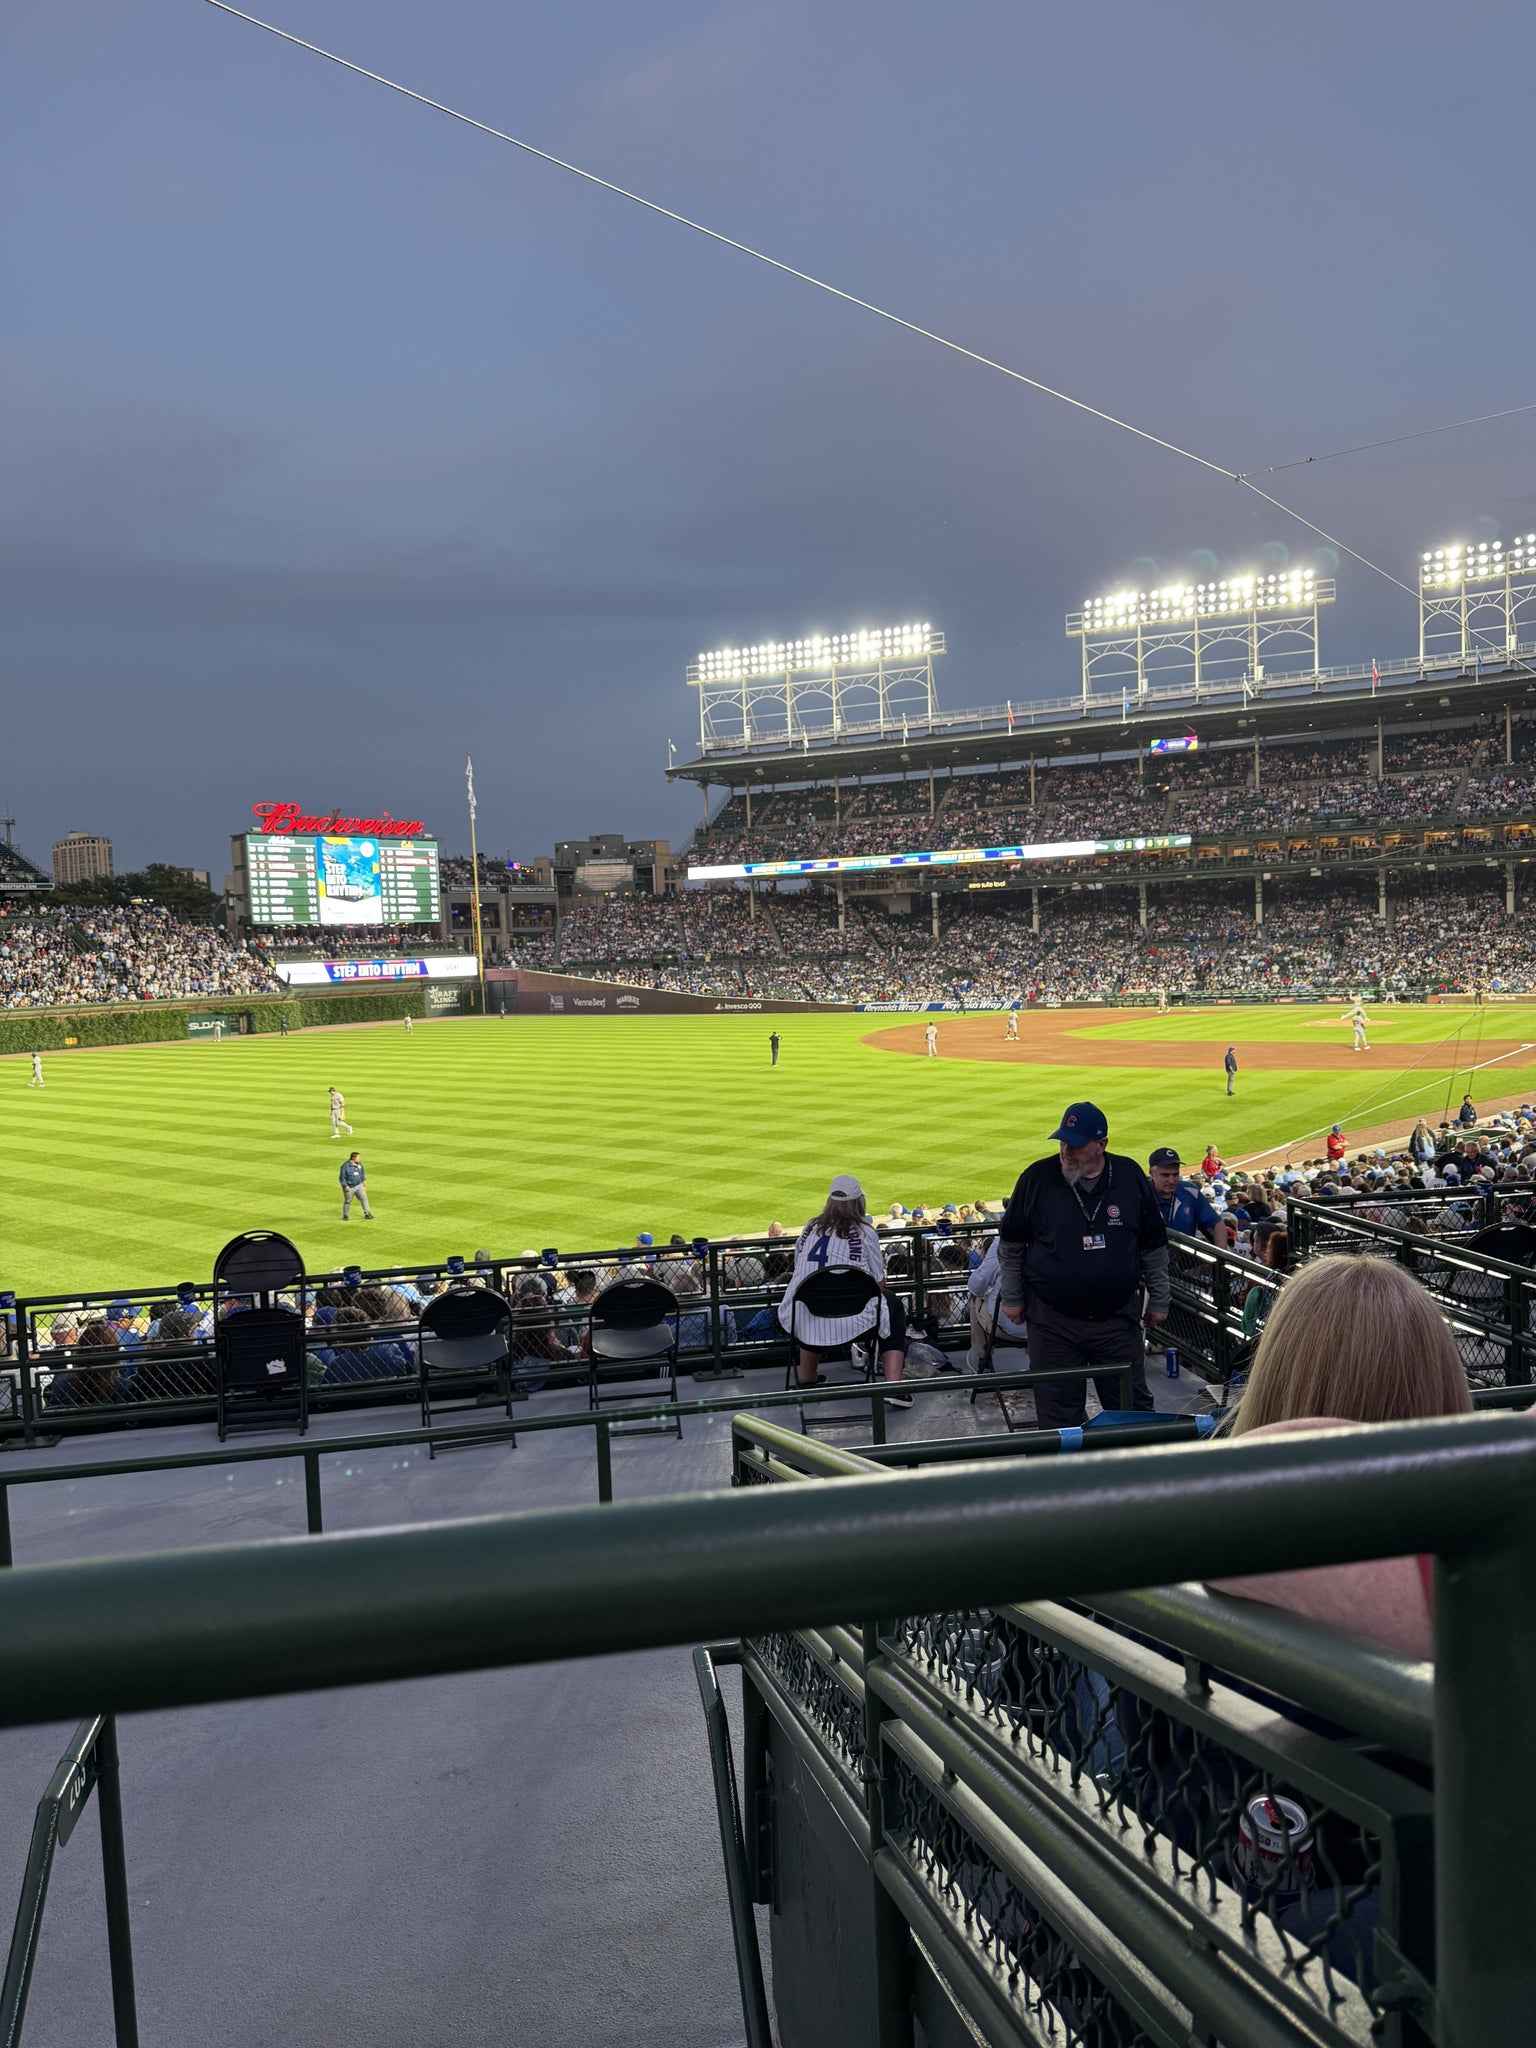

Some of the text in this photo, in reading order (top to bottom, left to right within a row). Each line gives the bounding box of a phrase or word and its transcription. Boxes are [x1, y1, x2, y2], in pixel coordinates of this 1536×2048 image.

[253, 802, 424, 835] Budweiser
[325, 863, 347, 875] STEP
[333, 963, 357, 978] STEP
[359, 963, 381, 977] INTO
[382, 962, 420, 976] RHYTHM
[430, 990, 459, 999] DRAFT
[616, 995, 640, 1006] MARQUEE
[979, 1001, 1002, 1010] Wrap
[864, 1003, 919, 1012] Reynolds Wrap
[1065, 1115, 1078, 1128] C
[1166, 1149, 1174, 1157] C
[807, 1235, 829, 1270] 4
